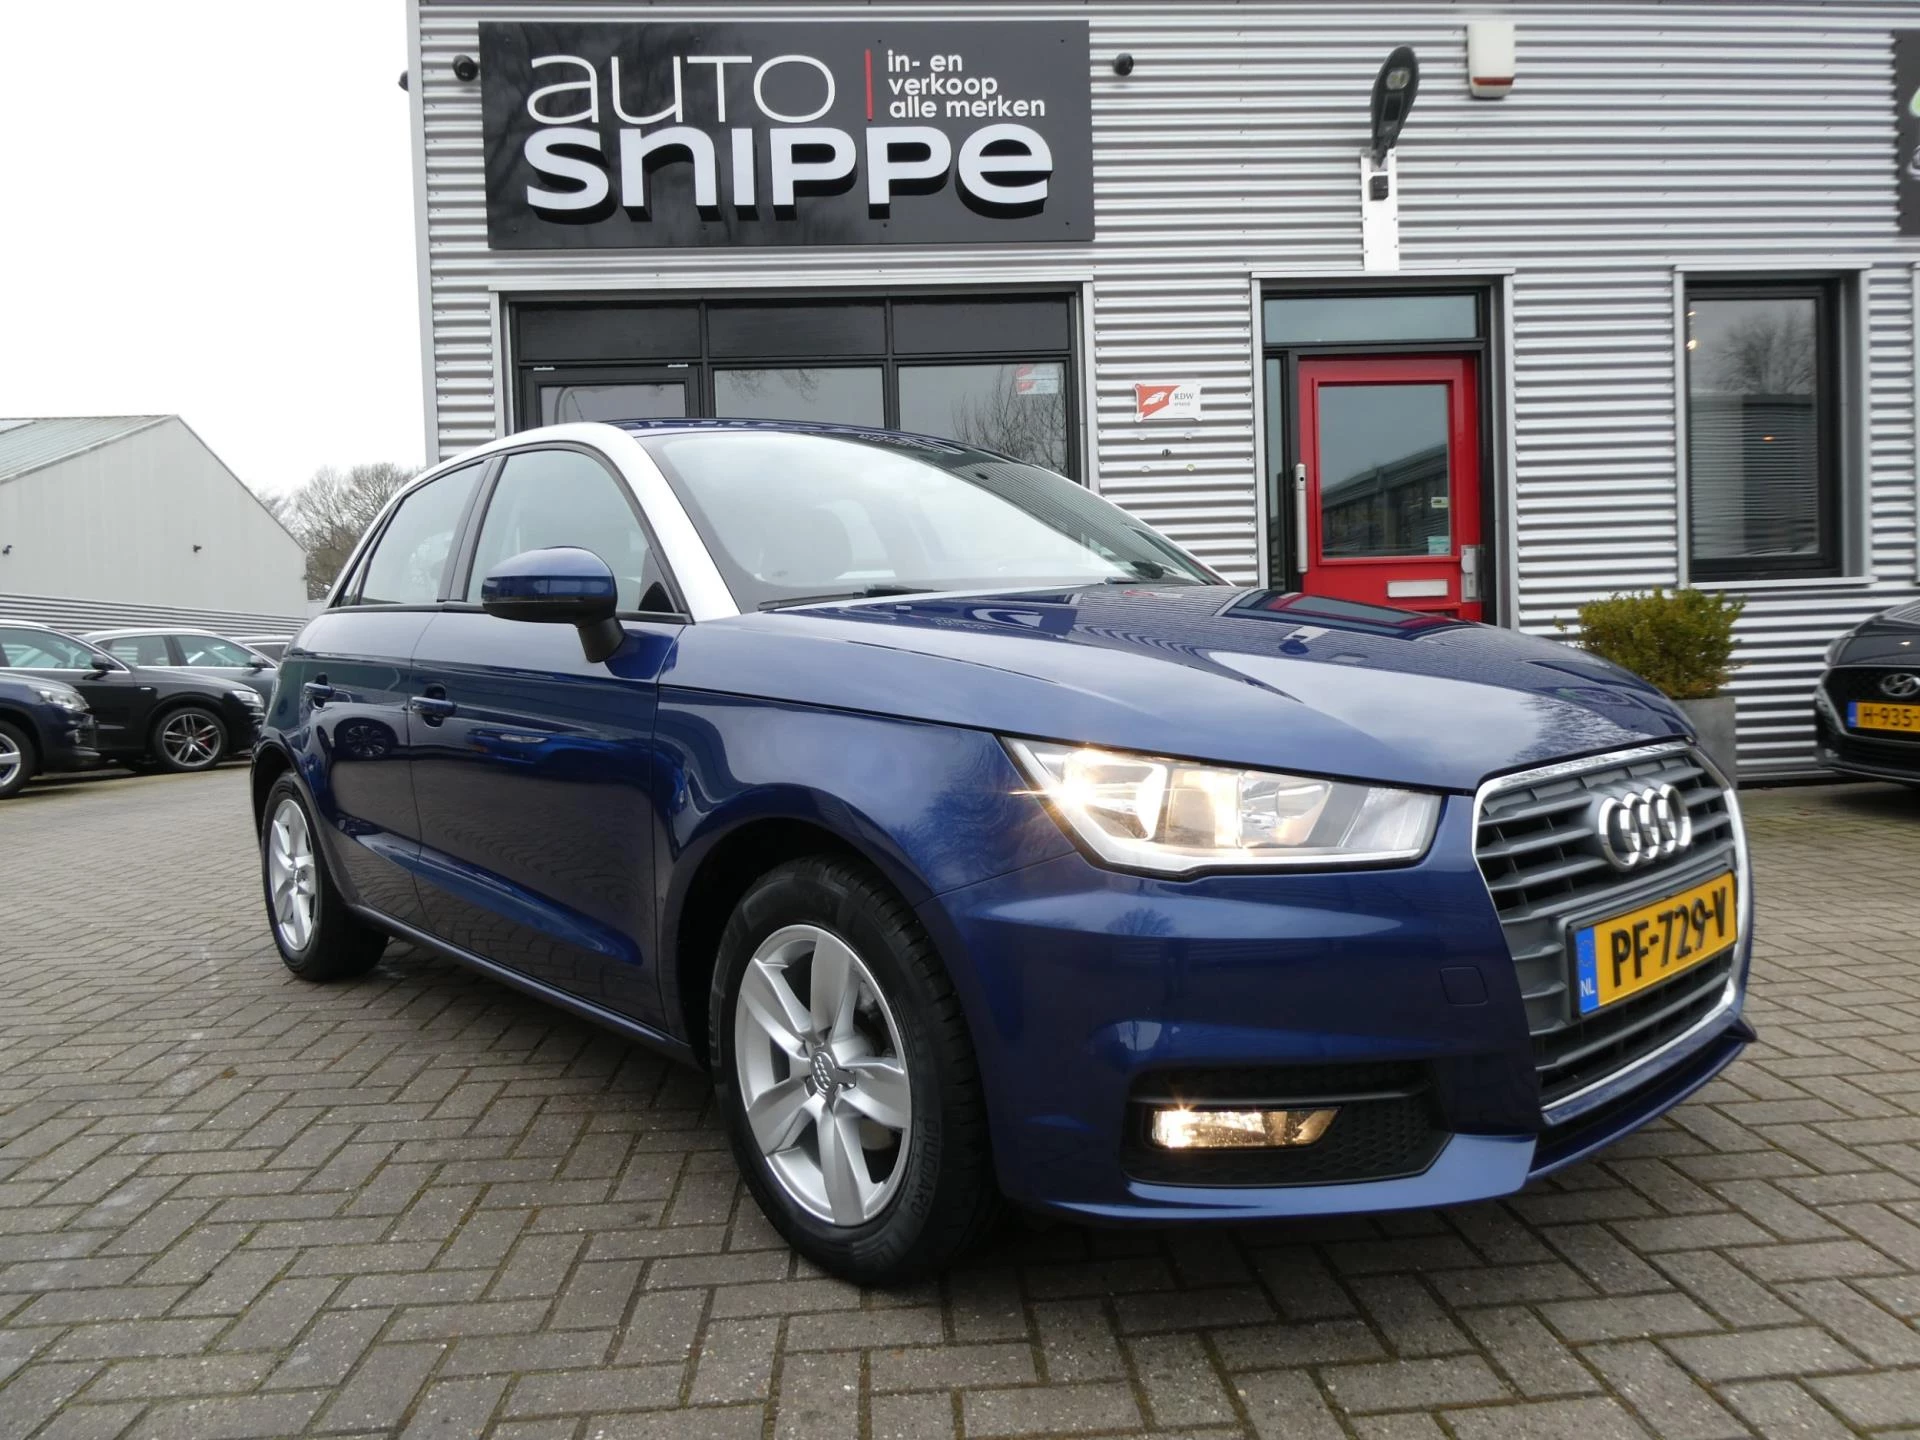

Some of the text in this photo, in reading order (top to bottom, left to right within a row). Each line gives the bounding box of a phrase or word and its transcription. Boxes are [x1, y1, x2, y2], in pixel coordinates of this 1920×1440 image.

[888, 49, 963, 72] in- en
[888, 73, 998, 100] verkoop
[889, 95, 1046, 118] alle merken
[1174, 392, 1194, 400] RDW
[1611, 886, 1726, 988] PF-729-V
[1580, 979, 1596, 997] NL
